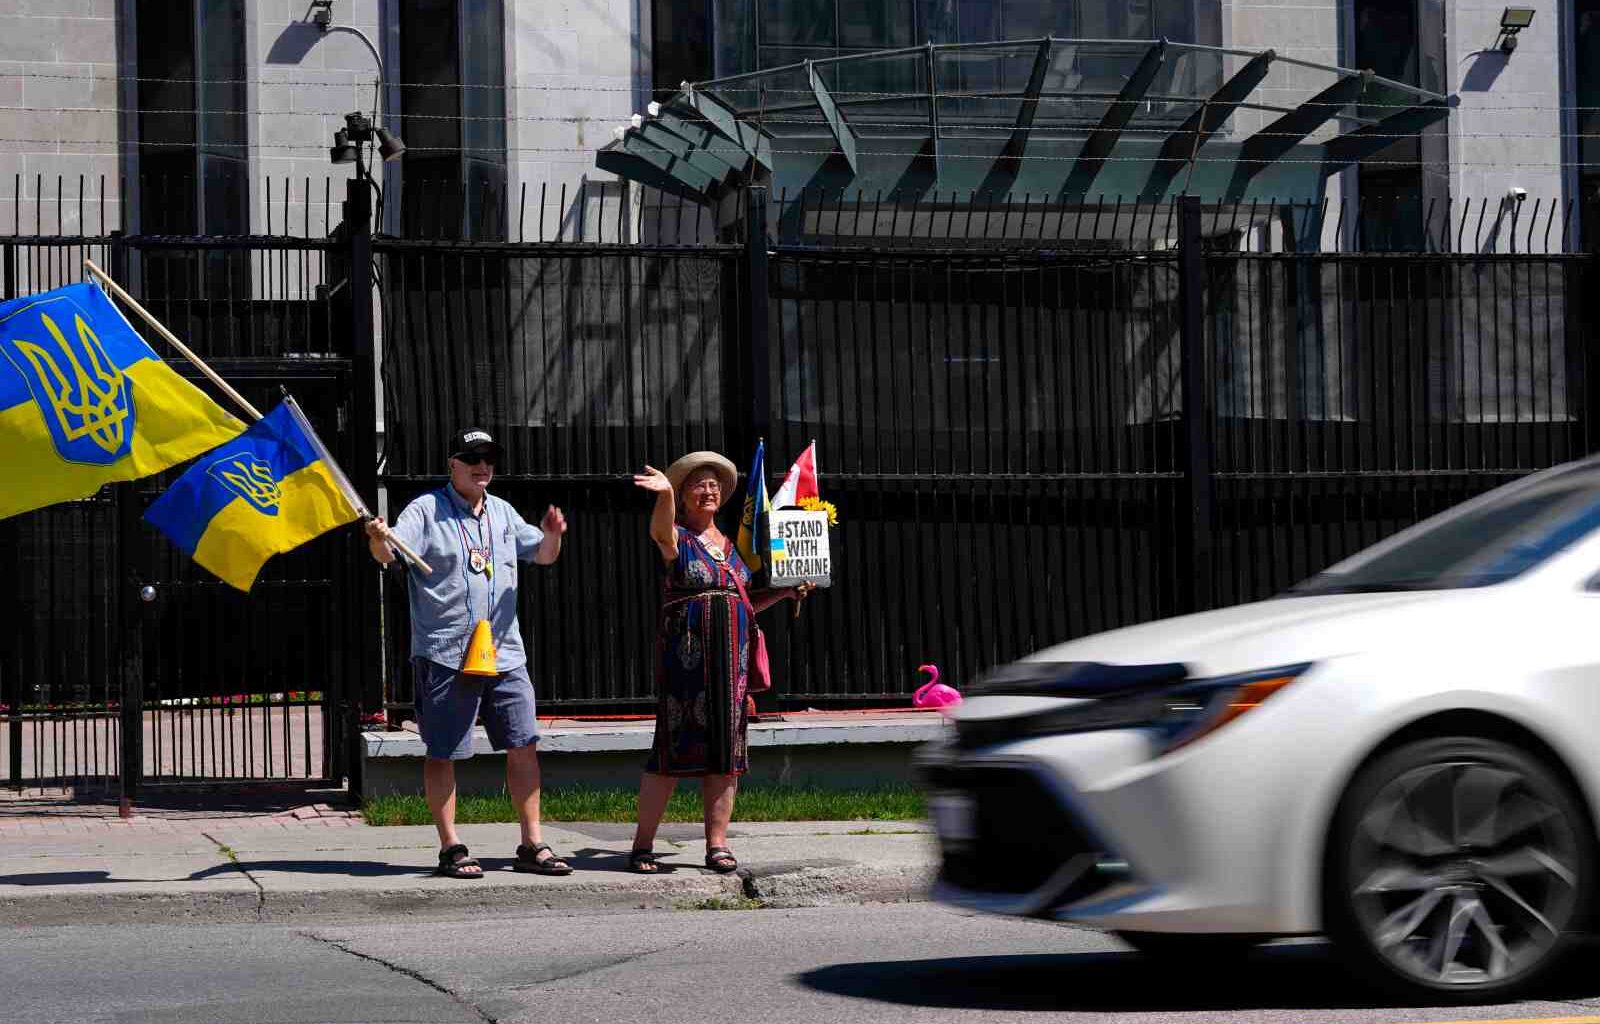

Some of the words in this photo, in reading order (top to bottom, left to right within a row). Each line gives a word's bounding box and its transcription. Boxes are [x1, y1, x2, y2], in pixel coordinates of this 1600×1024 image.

[778, 520, 822, 538] #STAND
[786, 539, 818, 557] WITH
[775, 558, 828, 577] UKRAINE
